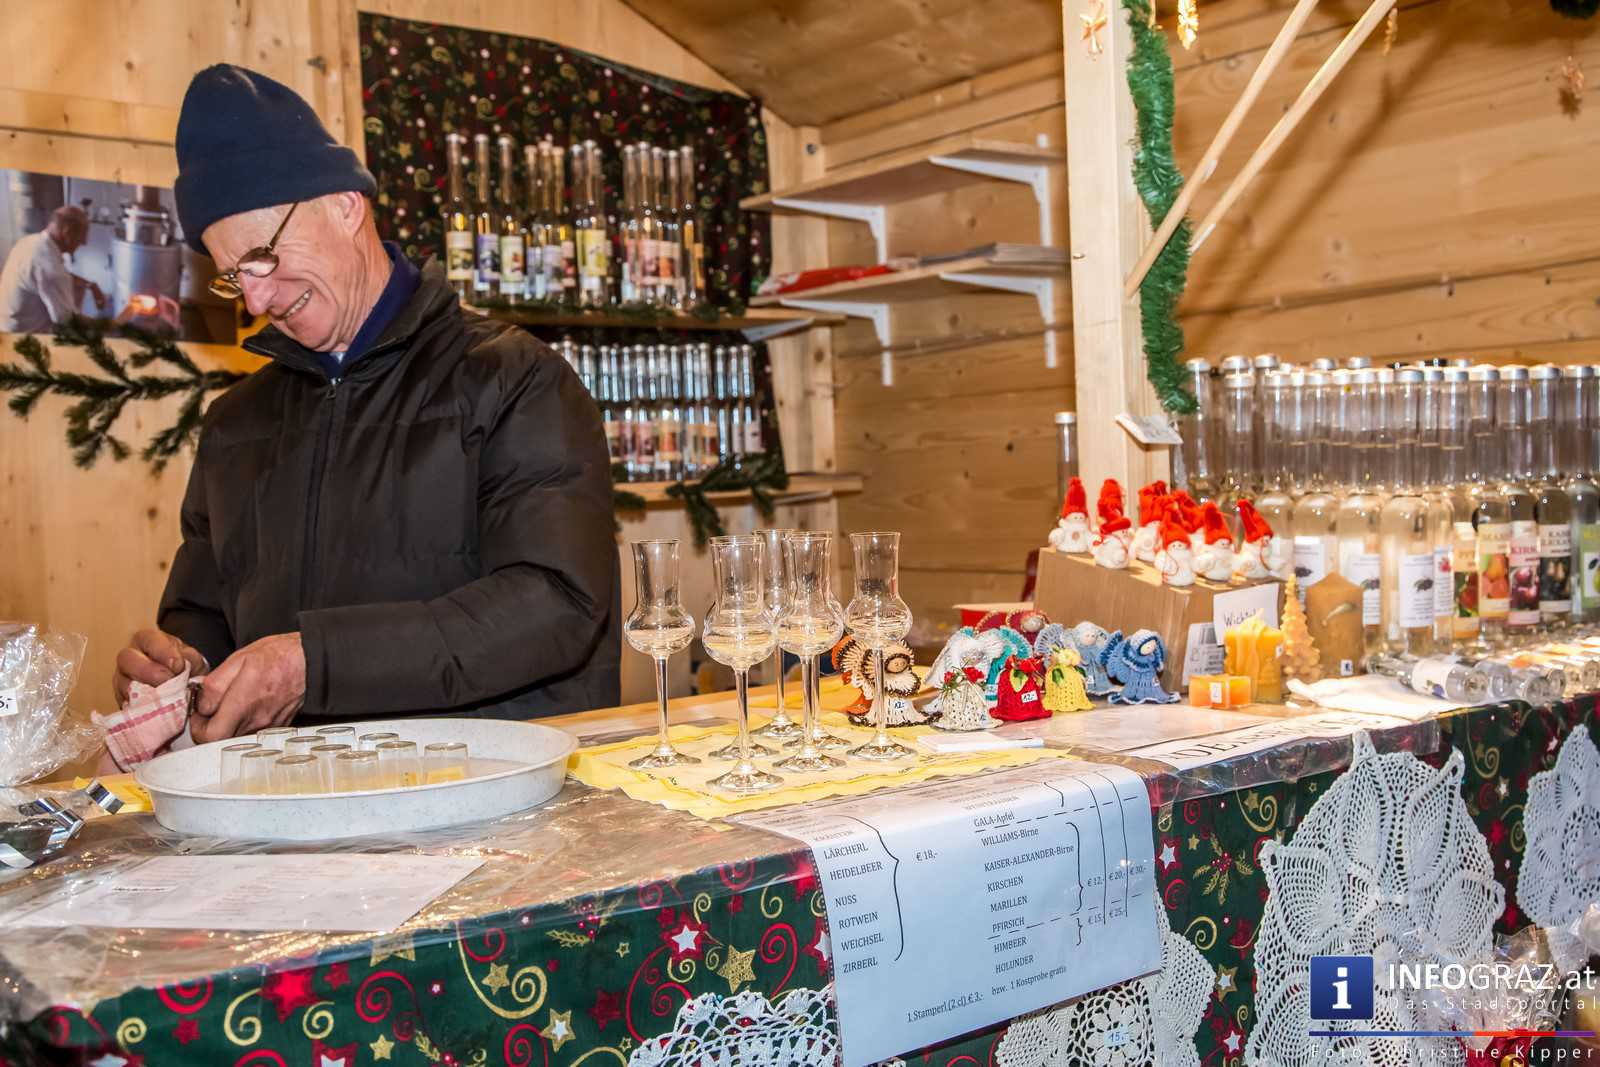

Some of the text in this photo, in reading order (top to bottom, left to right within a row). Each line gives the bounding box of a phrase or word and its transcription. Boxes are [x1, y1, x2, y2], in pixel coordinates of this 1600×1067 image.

[973, 810, 1015, 828] GALA-Apfel
[981, 827, 1039, 847] WILLIAMS-Birne
[823, 842, 869, 860] LÄRCHERL
[916, 849, 938, 861] € 18,-
[984, 845, 1074, 872] KAISER-ALEXANDER-Birne
[829, 861, 883, 881] HEIDELBEER
[987, 875, 1024, 893] KIRSCHEN
[835, 894, 857, 907] NUSS
[990, 895, 1028, 912] MARILLEN
[839, 911, 878, 930] ROTWEIN
[992, 916, 1025, 933] PFIRSICH
[841, 933, 884, 951] WEICHSEL
[994, 936, 1027, 953] HIMBEER
[843, 956, 878, 973] ZIRBERL
[995, 954, 1034, 974] HOLUNDER
[907, 1012, 911, 1023] 1
[913, 1001, 947, 1021] Stamperl
[967, 994, 973, 1004] €
[991, 985, 1008, 996] bzw.
[1010, 981, 1015, 989] 1
[1016, 970, 1048, 989] Kostprobe
[1049, 965, 1066, 979] gratis
